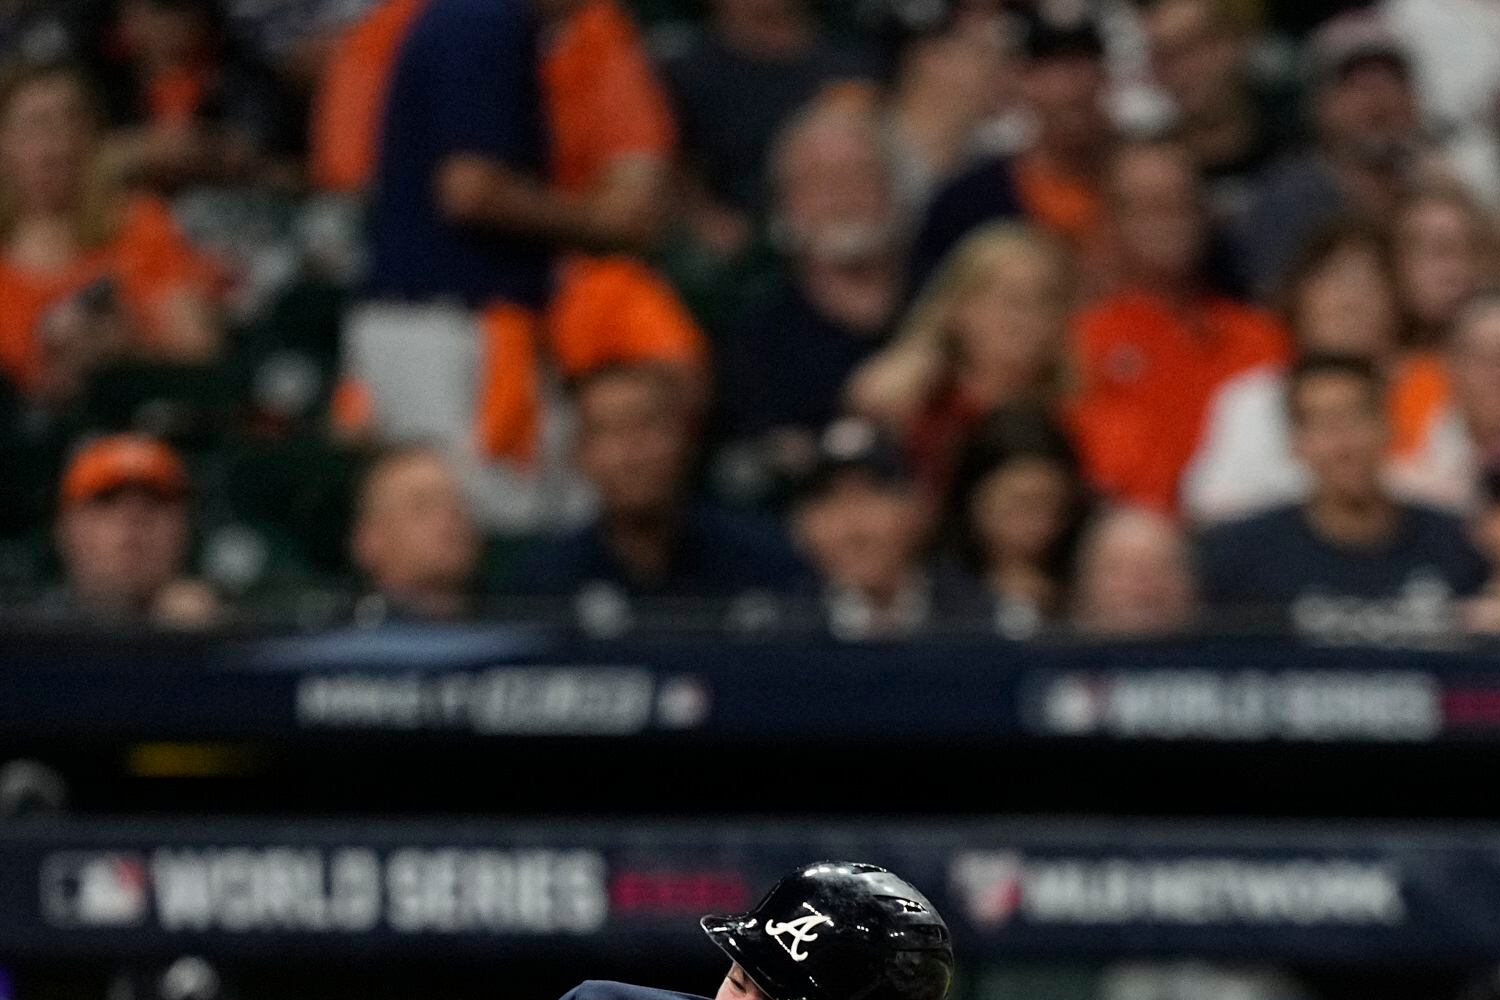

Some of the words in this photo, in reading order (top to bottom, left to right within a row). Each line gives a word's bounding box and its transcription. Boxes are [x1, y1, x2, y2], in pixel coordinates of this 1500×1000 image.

[152, 846, 382, 932] WORLD
[386, 846, 608, 932] SERIES
[766, 915, 831, 962] A
